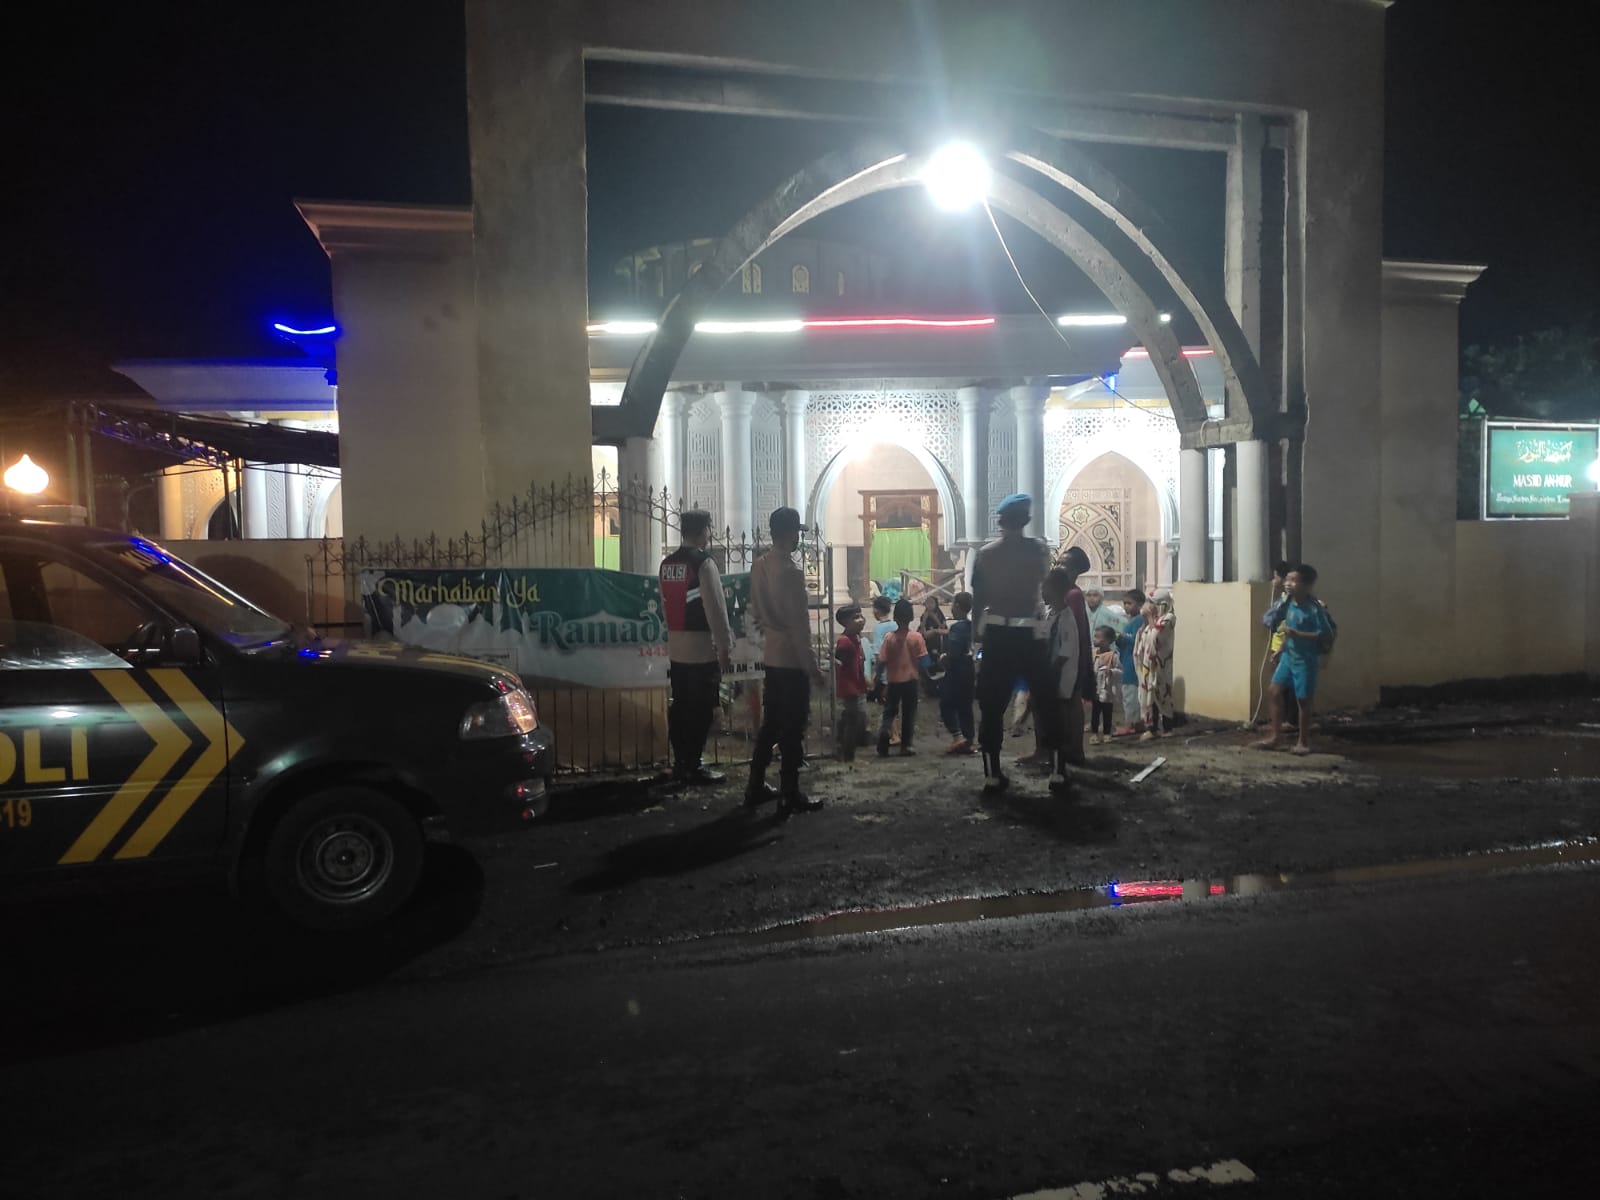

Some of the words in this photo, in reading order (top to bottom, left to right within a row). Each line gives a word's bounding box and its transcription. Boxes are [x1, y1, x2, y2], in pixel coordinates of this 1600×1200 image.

[660, 562, 686, 579] POLISI
[378, 576, 500, 607] Marhaban
[506, 576, 541, 608] Ya
